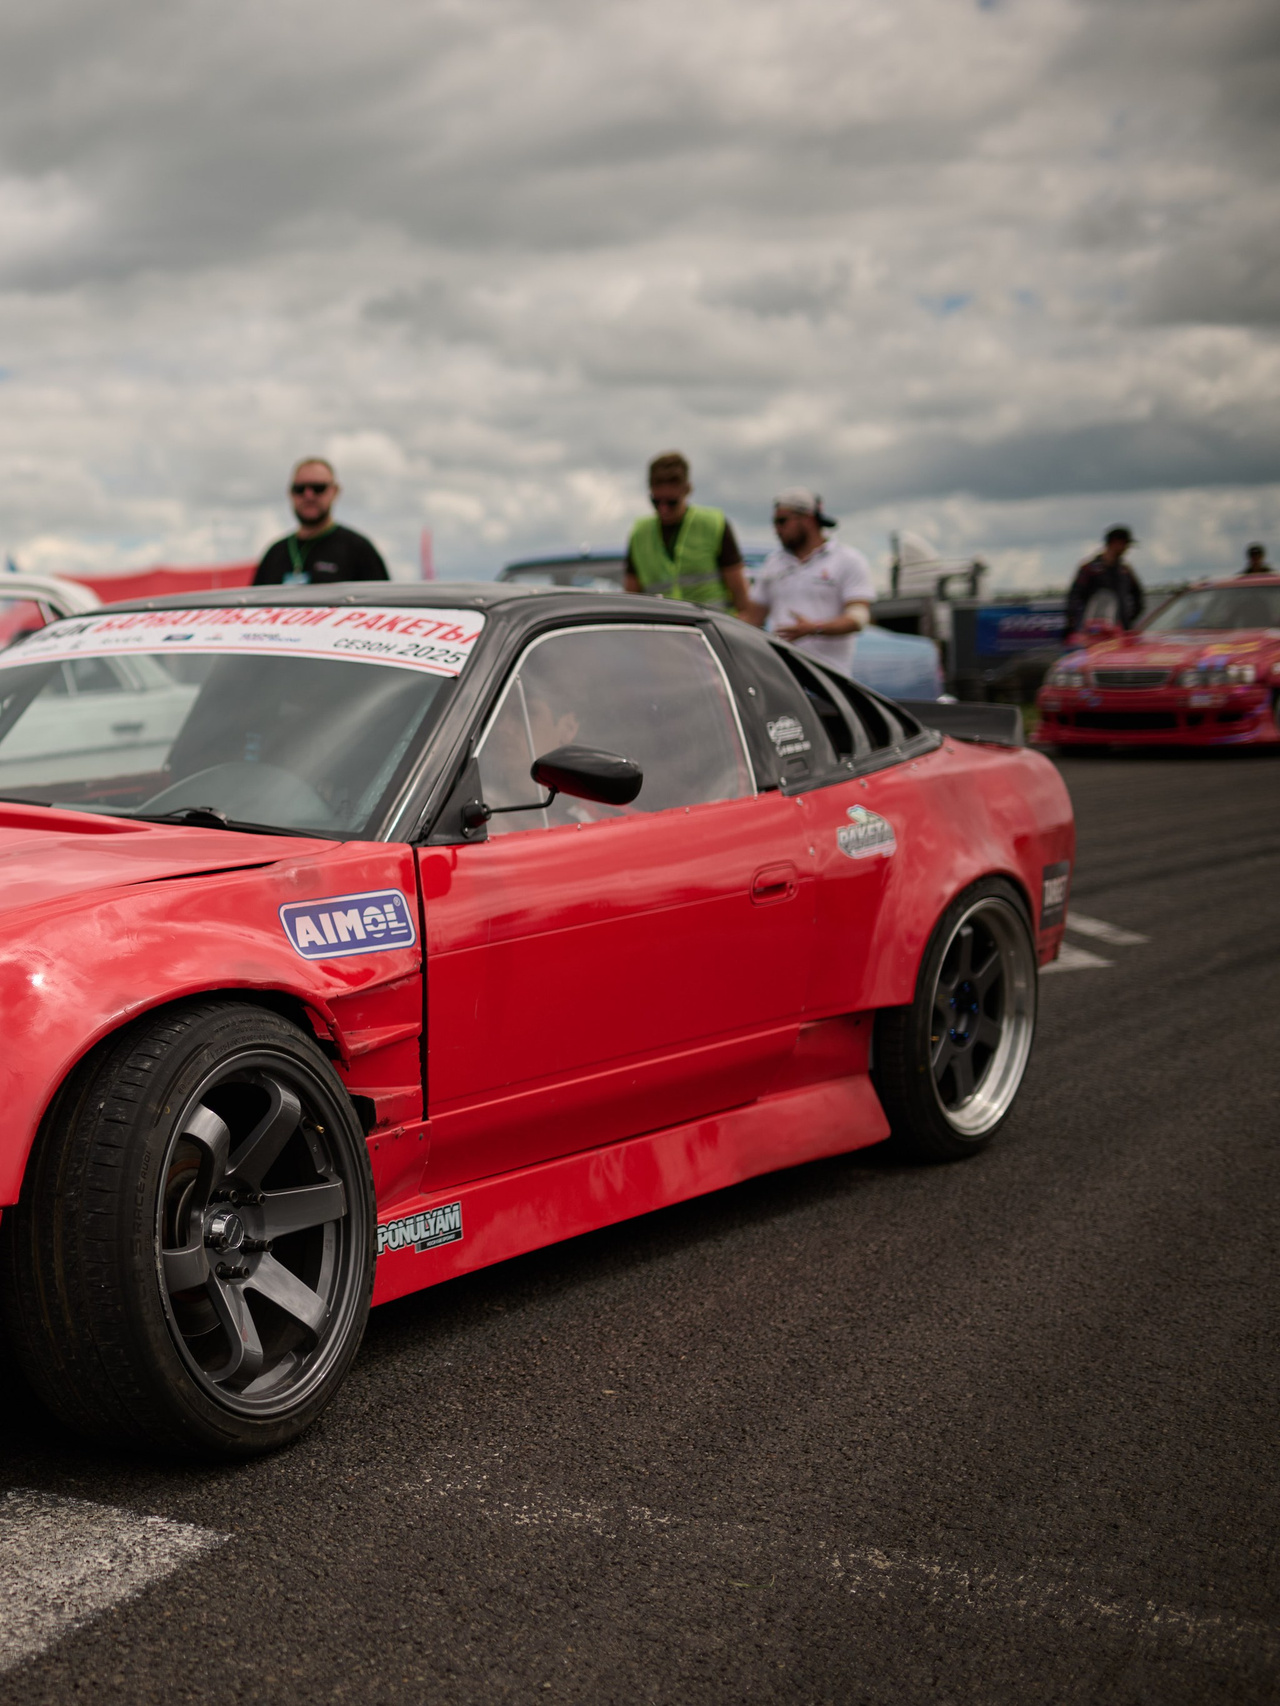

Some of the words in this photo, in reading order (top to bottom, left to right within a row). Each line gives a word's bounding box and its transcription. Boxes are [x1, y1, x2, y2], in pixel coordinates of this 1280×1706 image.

[332, 611, 483, 644] РАКЕТЫ
[333, 638, 397, 653] СЕЗОН
[397, 643, 468, 664] 2025
[295, 903, 408, 948] AIMOL
